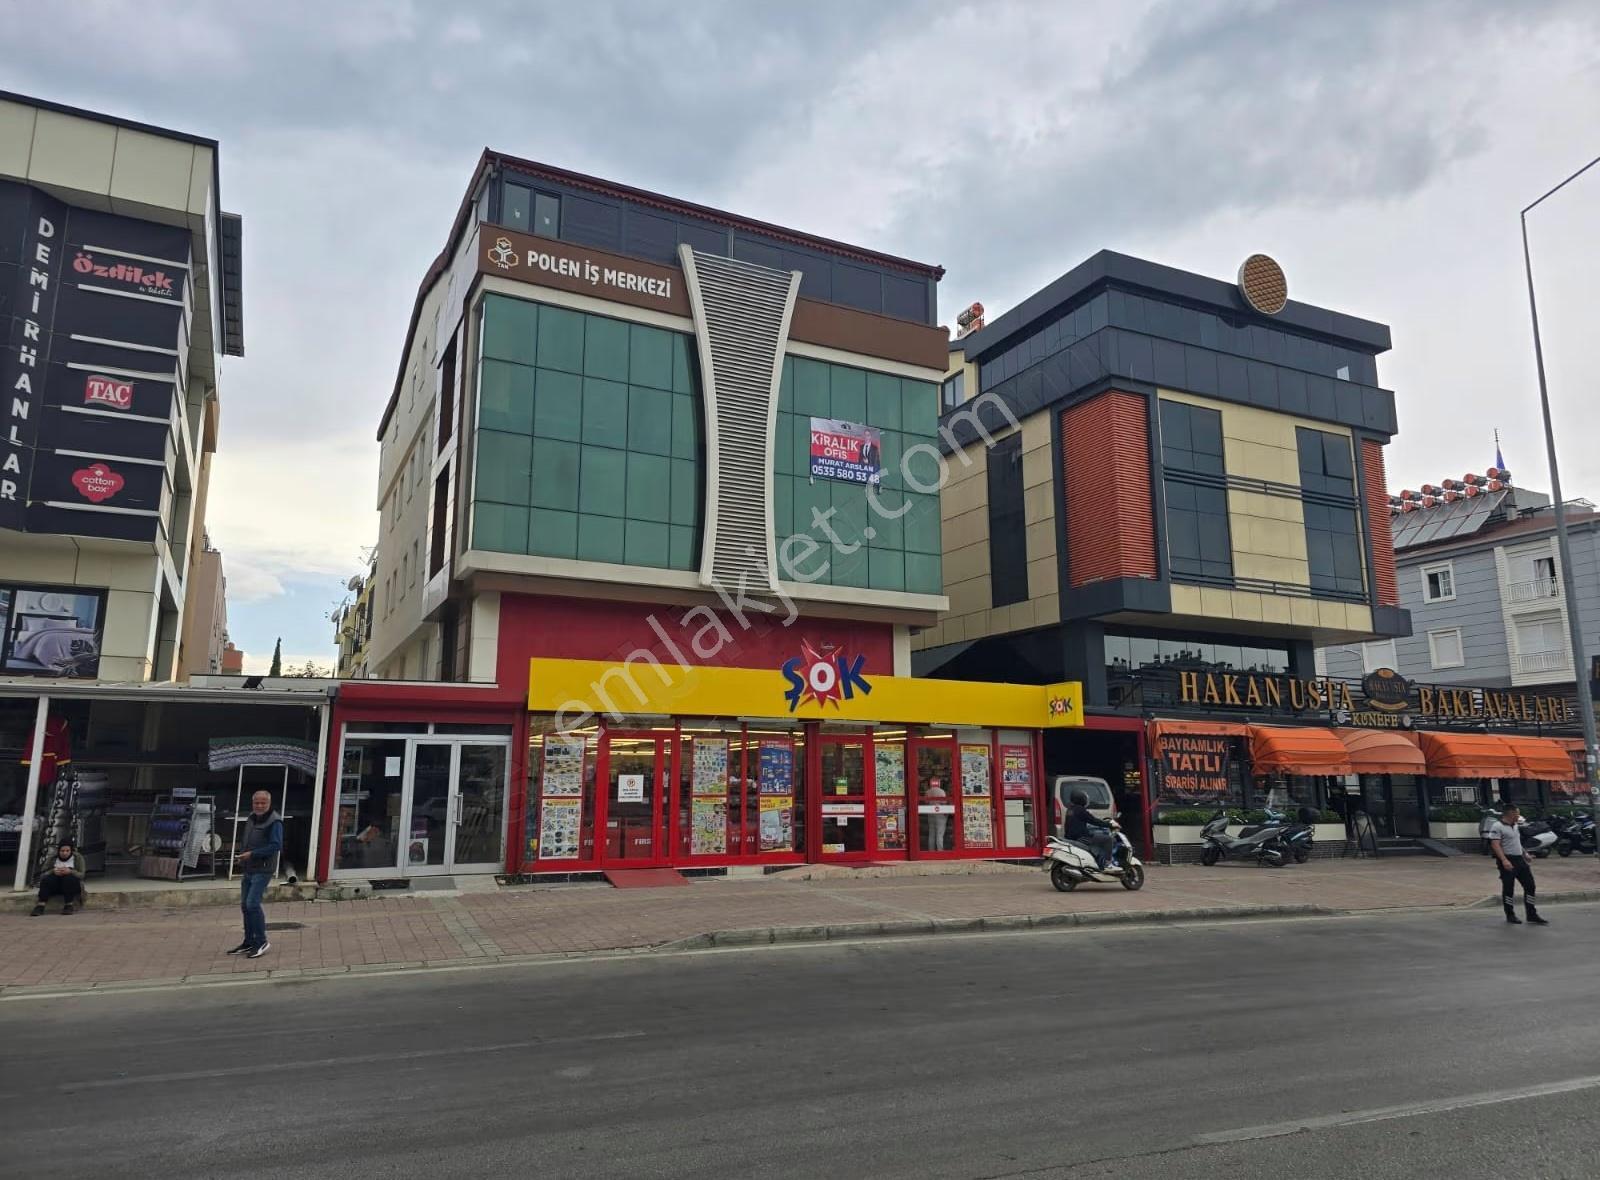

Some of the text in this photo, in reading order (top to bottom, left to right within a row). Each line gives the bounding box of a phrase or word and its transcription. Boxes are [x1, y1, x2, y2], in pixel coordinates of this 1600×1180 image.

[72, 252, 174, 290] Özdilek
[527, 250, 671, 298] POLEN İŞ MERKEZİ
[1, 216, 55, 501] DEMİRHANLAR
[88, 380, 131, 406] TAÇ
[812, 464, 835, 476] 0535
[836, 468, 854, 479] 580
[856, 472, 867, 482] 53
[818, 458, 874, 473] MURAT ARSLAN
[82, 476, 114, 486] cotton
[88, 484, 107, 493] box
[782, 653, 873, 713] ŞOK
[1180, 671, 1570, 722] HAKAN USTA BAKLAVALARI
[1049, 697, 1073, 719] ŞOK
[1160, 737, 1225, 753] BAYRAMLIK
[1168, 752, 1221, 773] TATLI
